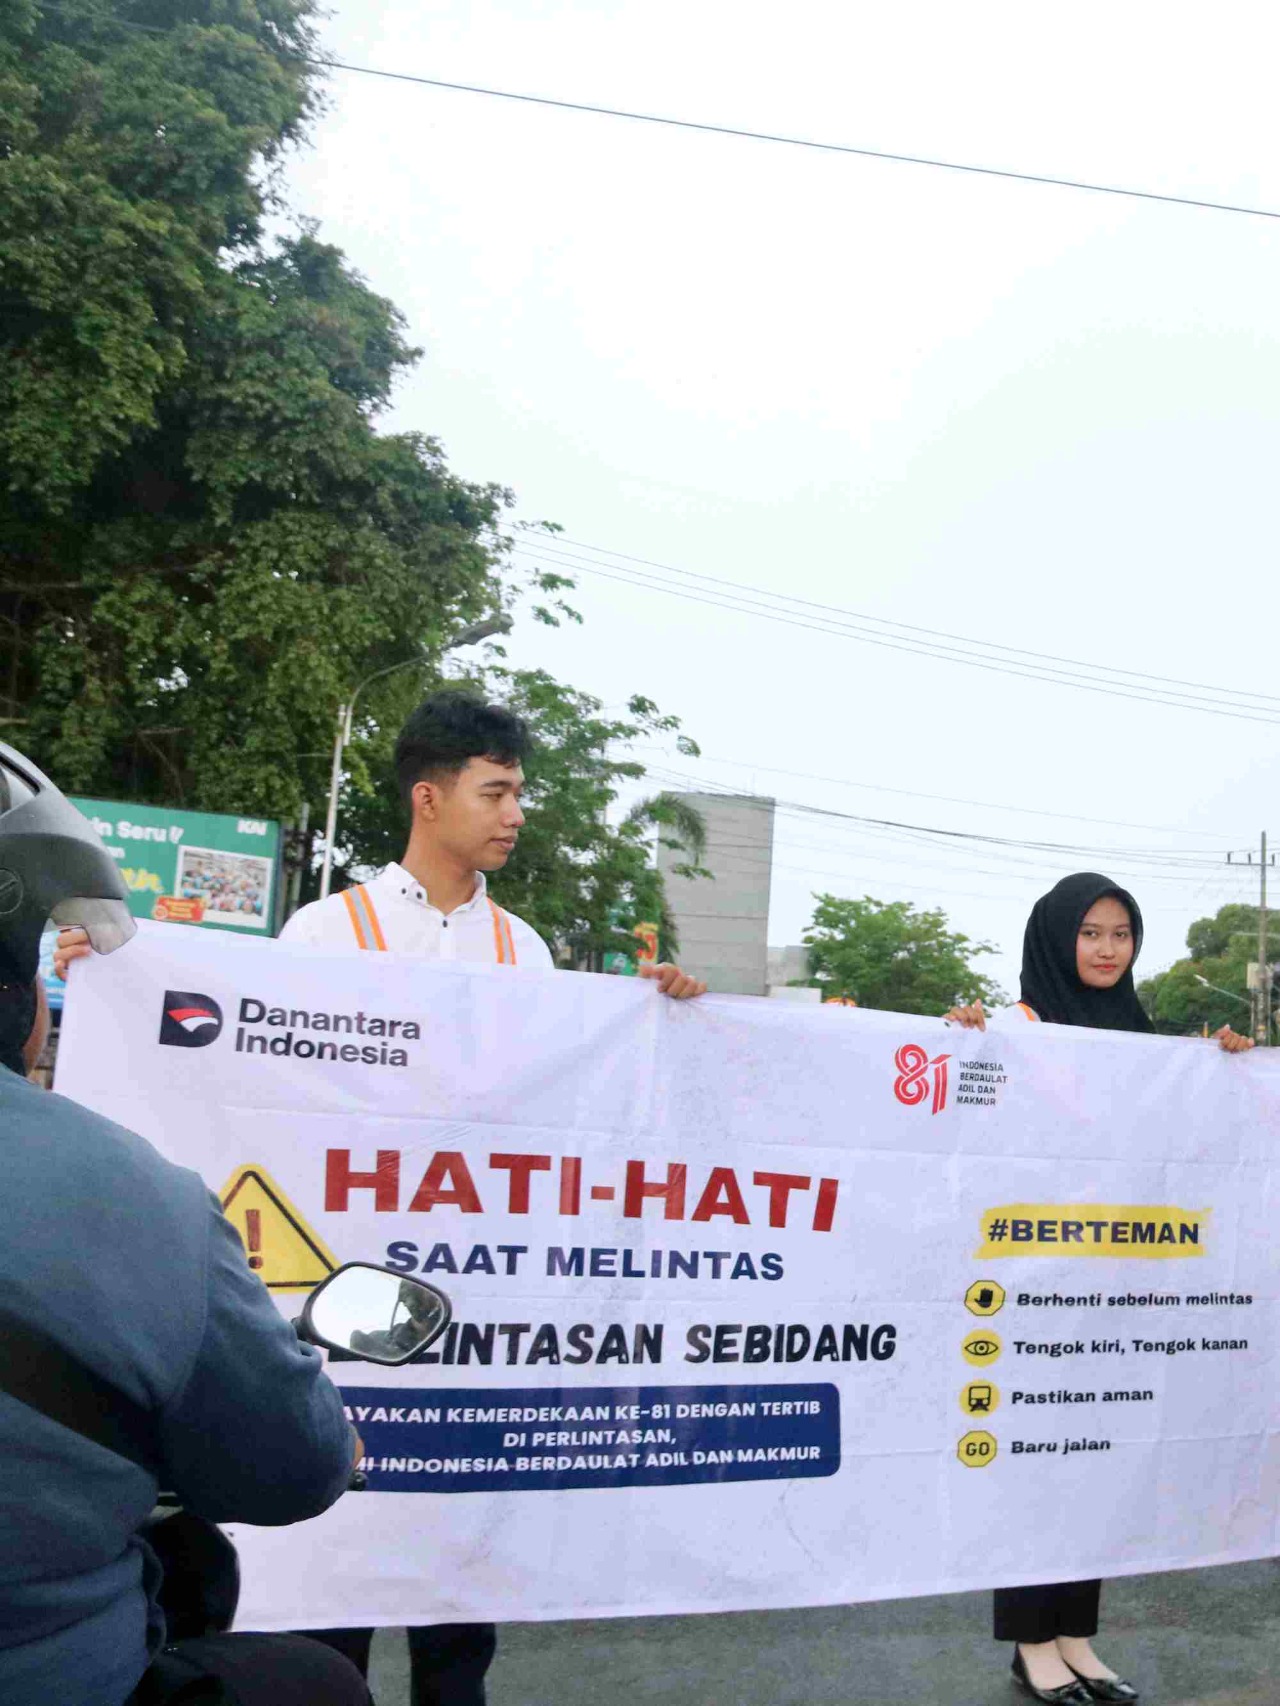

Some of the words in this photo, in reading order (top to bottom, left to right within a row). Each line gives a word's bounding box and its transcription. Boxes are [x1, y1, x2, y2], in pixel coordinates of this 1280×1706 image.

[239, 998, 421, 1040] Danantara
[235, 1027, 409, 1067] Indonesia
[959, 1061, 1004, 1072] INDONESIA
[960, 1072, 1008, 1084] BERDAULAT
[958, 1084, 975, 1093] ADIL
[978, 1085, 996, 1095] DAN
[956, 1096, 996, 1106] MAKMUR
[324, 1149, 839, 1232] HATI-HATI
[988, 1219, 1199, 1245] #BERTEMAN
[385, 1241, 528, 1276] SAAT
[546, 1246, 784, 1281] MELINTAS
[1017, 1293, 1102, 1307] Berhenti
[1107, 1293, 1181, 1307] sebelum
[1186, 1292, 1253, 1306] melintas
[684, 1324, 897, 1364] SEBIDANG
[1014, 1341, 1085, 1358] Tengok
[1091, 1339, 1126, 1355] kiri,
[1132, 1338, 1197, 1355] Tengok
[1202, 1337, 1249, 1351] kanan
[1011, 1390, 1097, 1405] Pastikan
[1102, 1389, 1154, 1403] aman
[343, 1406, 441, 1424] AYAKAN
[447, 1405, 610, 1424] KEMERDEKAAN
[615, 1403, 671, 1421] KE-81
[676, 1402, 756, 1419] DENGAN
[761, 1400, 821, 1416] TERTIB
[503, 1432, 526, 1448] DI
[532, 1428, 677, 1447] PERLINTASAN,
[1011, 1441, 1058, 1454] Baru
[1063, 1438, 1111, 1455] jalan
[380, 1457, 510, 1473] INDONESIA
[515, 1454, 641, 1472] BERDAULAT
[645, 1454, 689, 1468] ADIL
[693, 1450, 734, 1464] DAN
[737, 1445, 820, 1463] MAKMUR
[965, 1442, 990, 1457] GO
